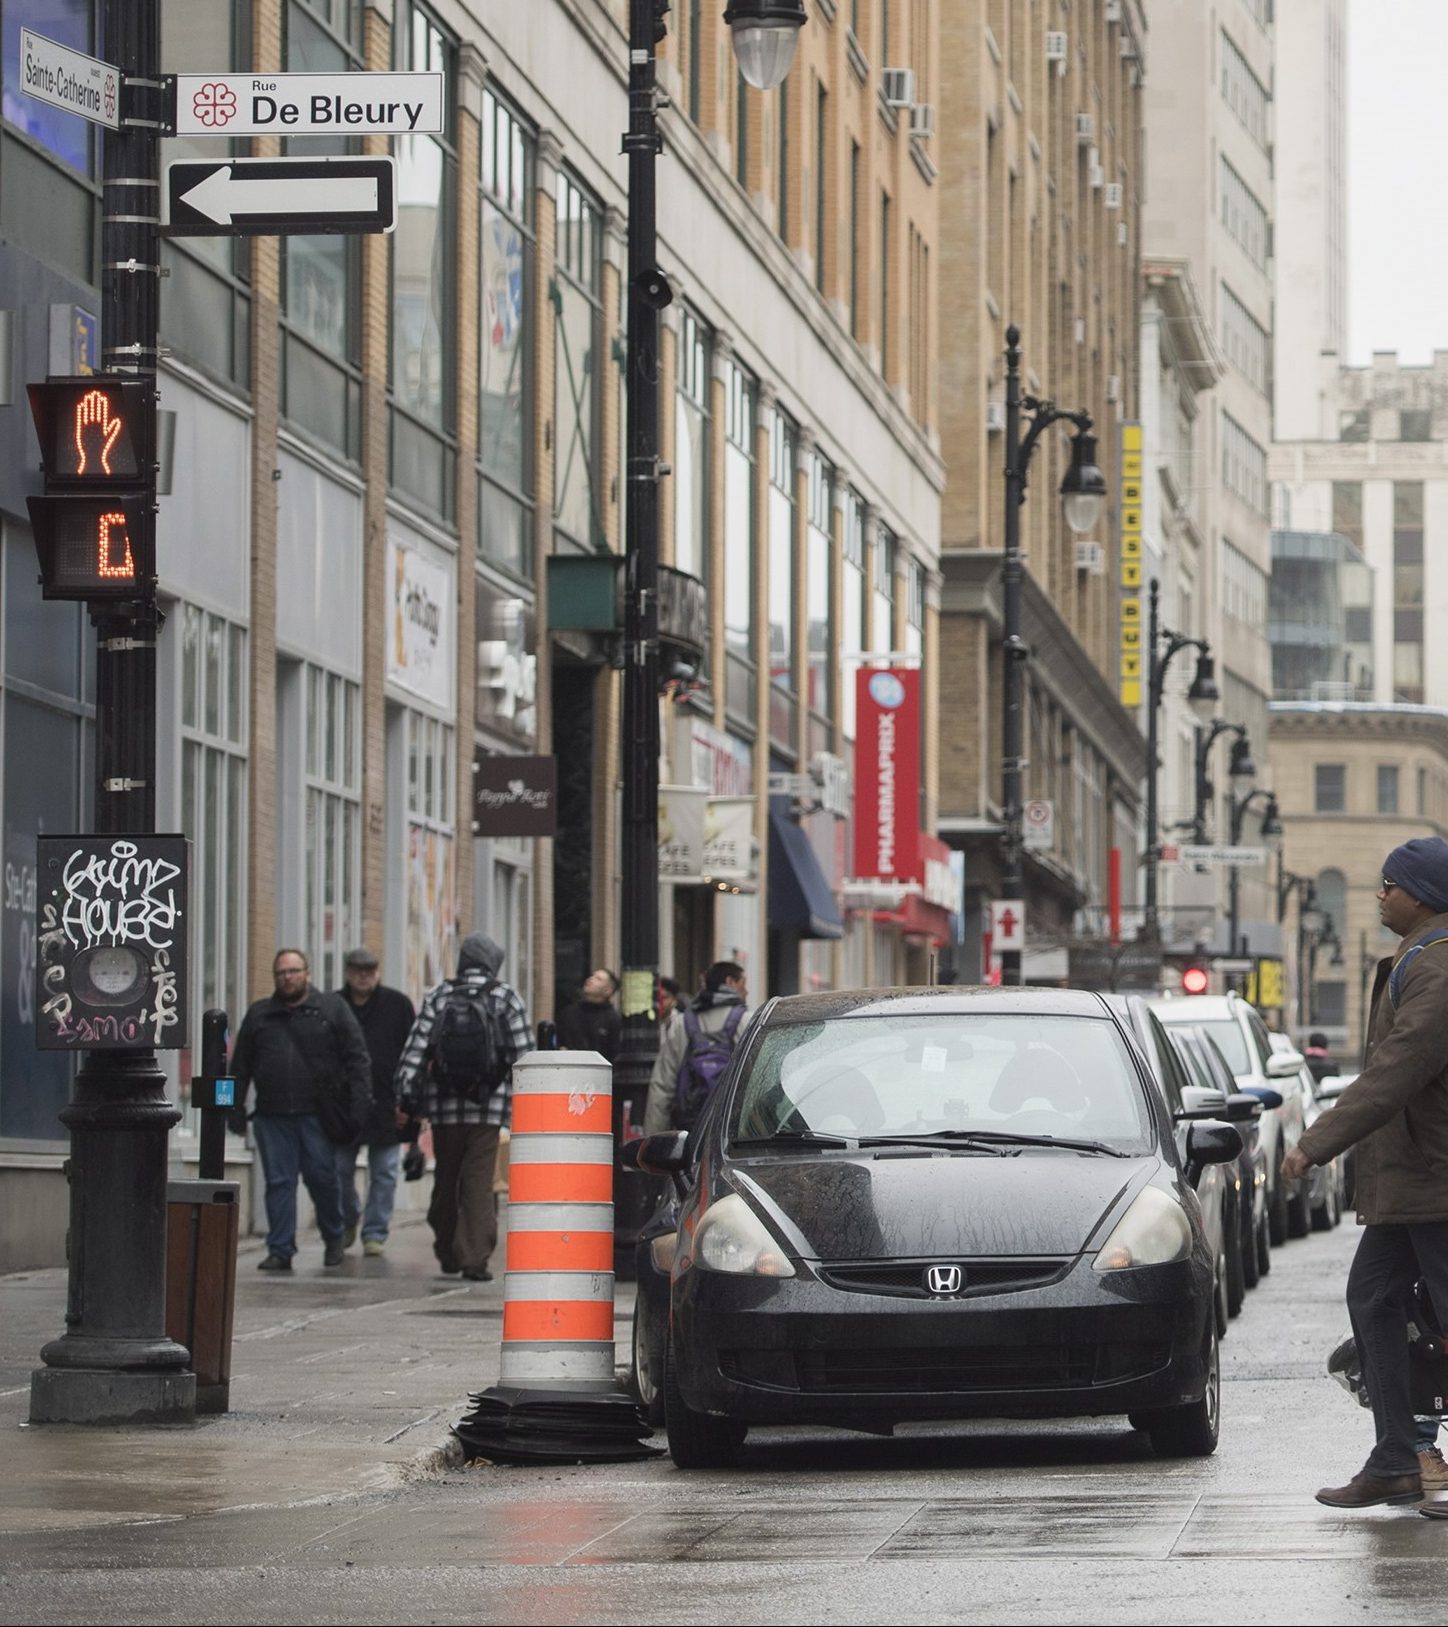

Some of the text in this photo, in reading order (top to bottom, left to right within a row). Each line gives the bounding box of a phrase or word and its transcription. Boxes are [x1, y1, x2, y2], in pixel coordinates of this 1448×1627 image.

[25, 53, 101, 112] Sainte-Catherine
[252, 80, 277, 91] Rue
[252, 95, 423, 130] De Bleury
[877, 713, 896, 875] PHARMAPRIX
